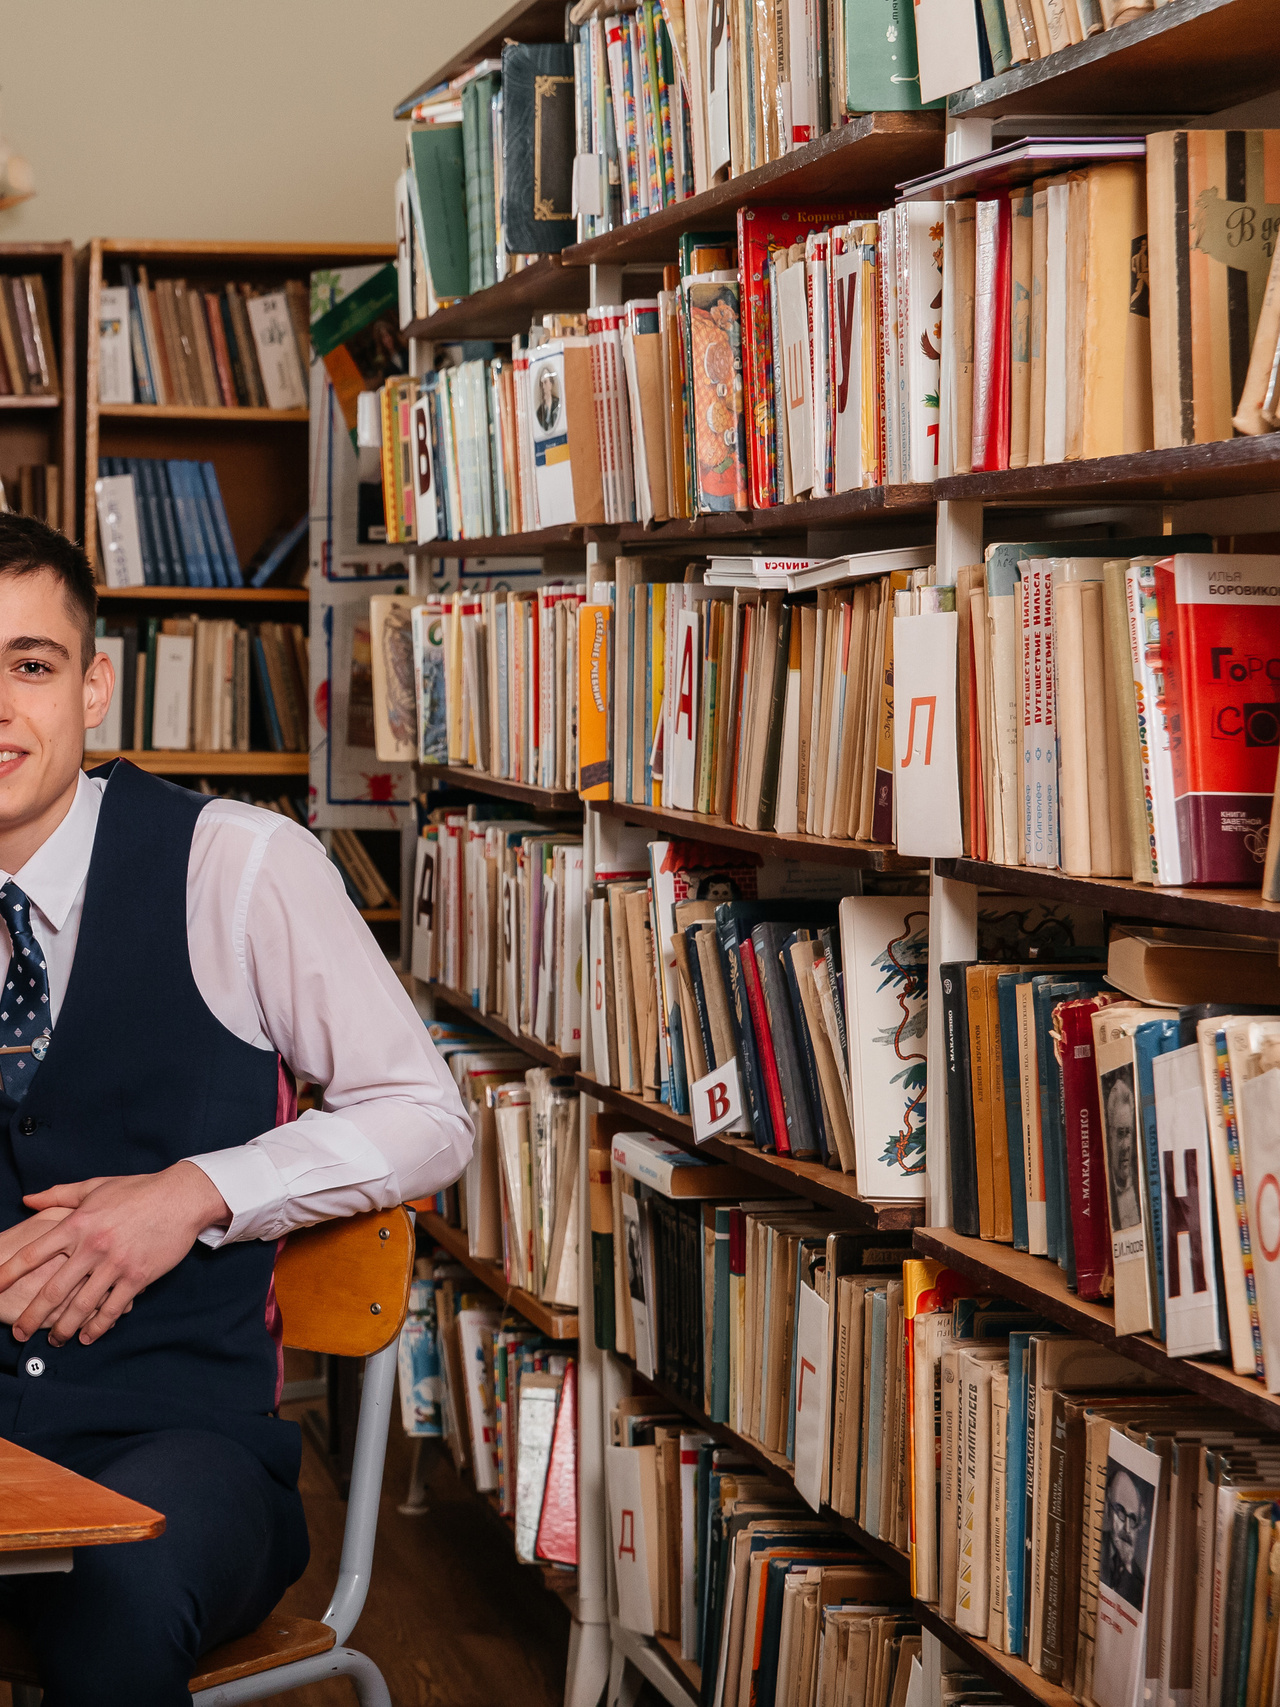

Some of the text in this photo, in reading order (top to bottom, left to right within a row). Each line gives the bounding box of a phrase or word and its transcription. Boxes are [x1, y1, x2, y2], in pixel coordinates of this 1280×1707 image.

[776, 9, 784, 72] ПРИКЛЮЧЕНИЯ
[797, 210, 845, 224] Корней
[963, 364, 969, 374] 2
[416, 407, 431, 496] В
[764, 561, 809, 570] НИЛЬСА
[1208, 571, 1242, 582] ИЛЬЯ
[1209, 585, 1280, 597] БОРОВИКО
[1022, 575, 1030, 629] НИЛЬСА
[1044, 573, 1052, 627] НИЛЬСА
[590, 660, 606, 713] УЧЕБНИКИ
[676, 625, 694, 741] А
[1023, 634, 1031, 727] ПУТЕШЕСТВИЕ
[1034, 631, 1042, 724] ПУТЕШЕСТВИЕ
[902, 696, 937, 768] Л
[1133, 681, 1149, 764] МАЛЫШ
[1144, 785, 1159, 874] КАРЛСОН
[1220, 817, 1262, 826] ЗАВЕТНОЙ
[595, 958, 603, 1010] Б
[824, 946, 847, 1049] ПИТЕРСКИЕ УМЕЛЬЦЫ
[947, 1009, 956, 1073] А. МАКАРЕНКО
[705, 1081, 730, 1125] В
[1080, 1108, 1090, 1218] А. МАКАРЕНКО
[1148, 1124, 1160, 1187] Носов
[1229, 1118, 1241, 1172] капитана
[1162, 1149, 1208, 1297] Н
[1235, 1174, 1250, 1255] Приключения
[1247, 1273, 1258, 1327] Некрасов
[838, 1325, 847, 1403] ТАШКЕНТЦЫ
[1253, 1330, 1263, 1375] Андрей
[797, 1357, 816, 1412] Г
[945, 1410, 953, 1501] БОРИС ПОЛЕВОЙ
[957, 1444, 963, 1465] ДО
[1056, 1455, 1065, 1516] ПРИЛЕЖАЕВА
[618, 1509, 636, 1562] Д
